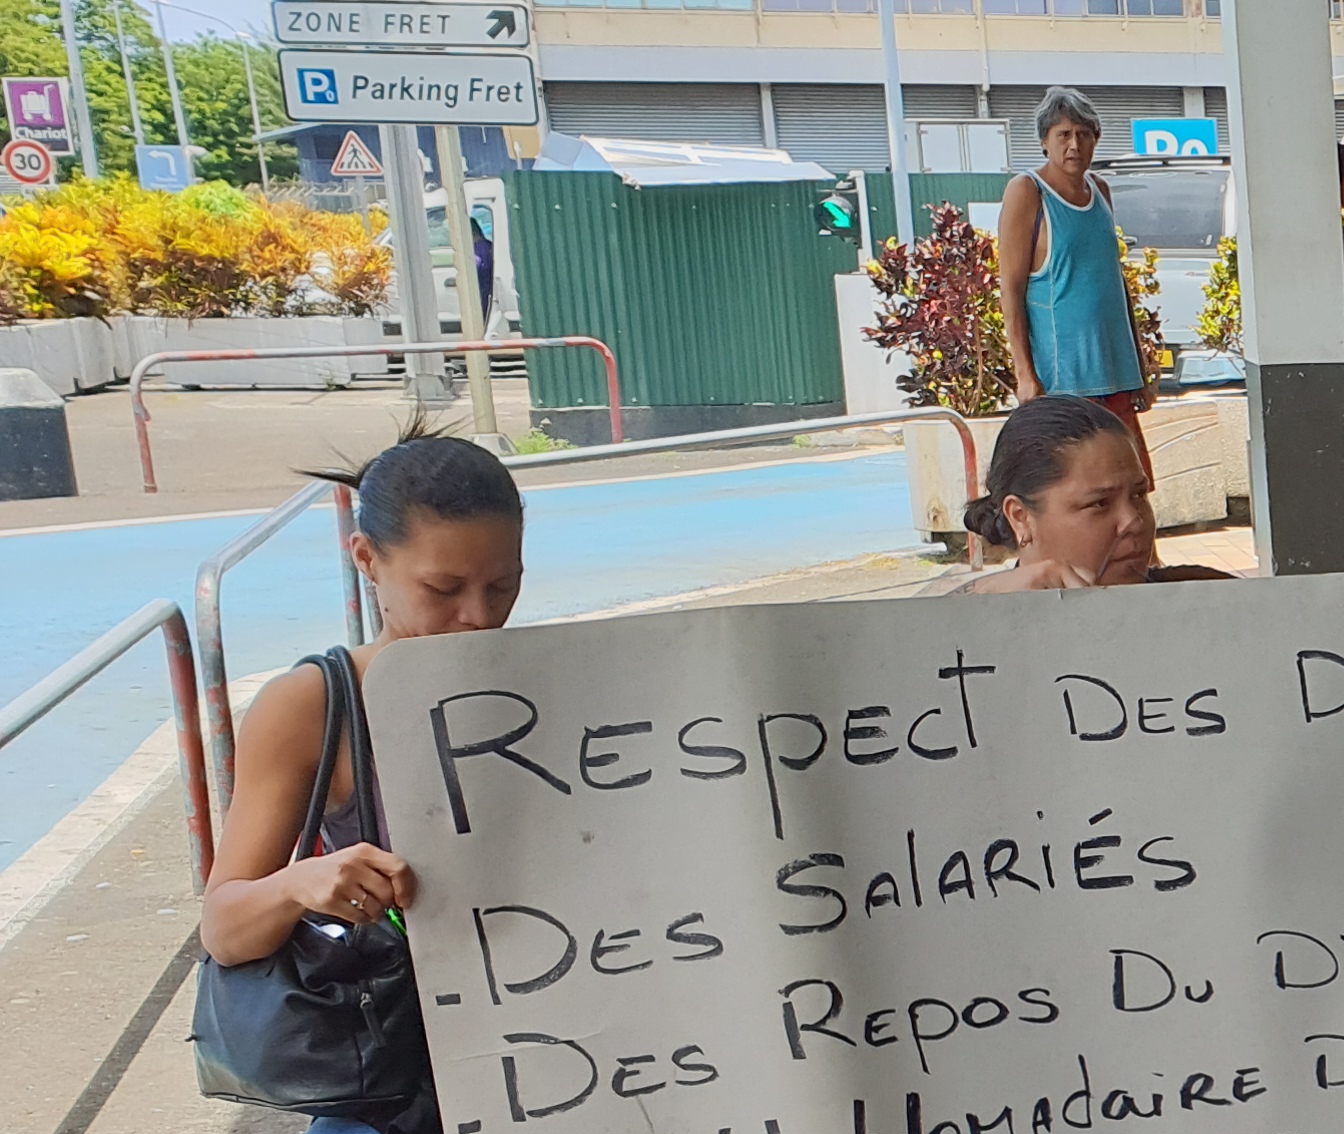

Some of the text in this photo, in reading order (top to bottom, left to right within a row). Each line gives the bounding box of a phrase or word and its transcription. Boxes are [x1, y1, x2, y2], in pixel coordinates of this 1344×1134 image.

[287, 11, 451, 34] ZONE FRET
[351, 75, 460, 108] Parking
[468, 78, 525, 103] Fret
[15, 127, 68, 139] Chariot
[14, 153, 42, 171] 30
